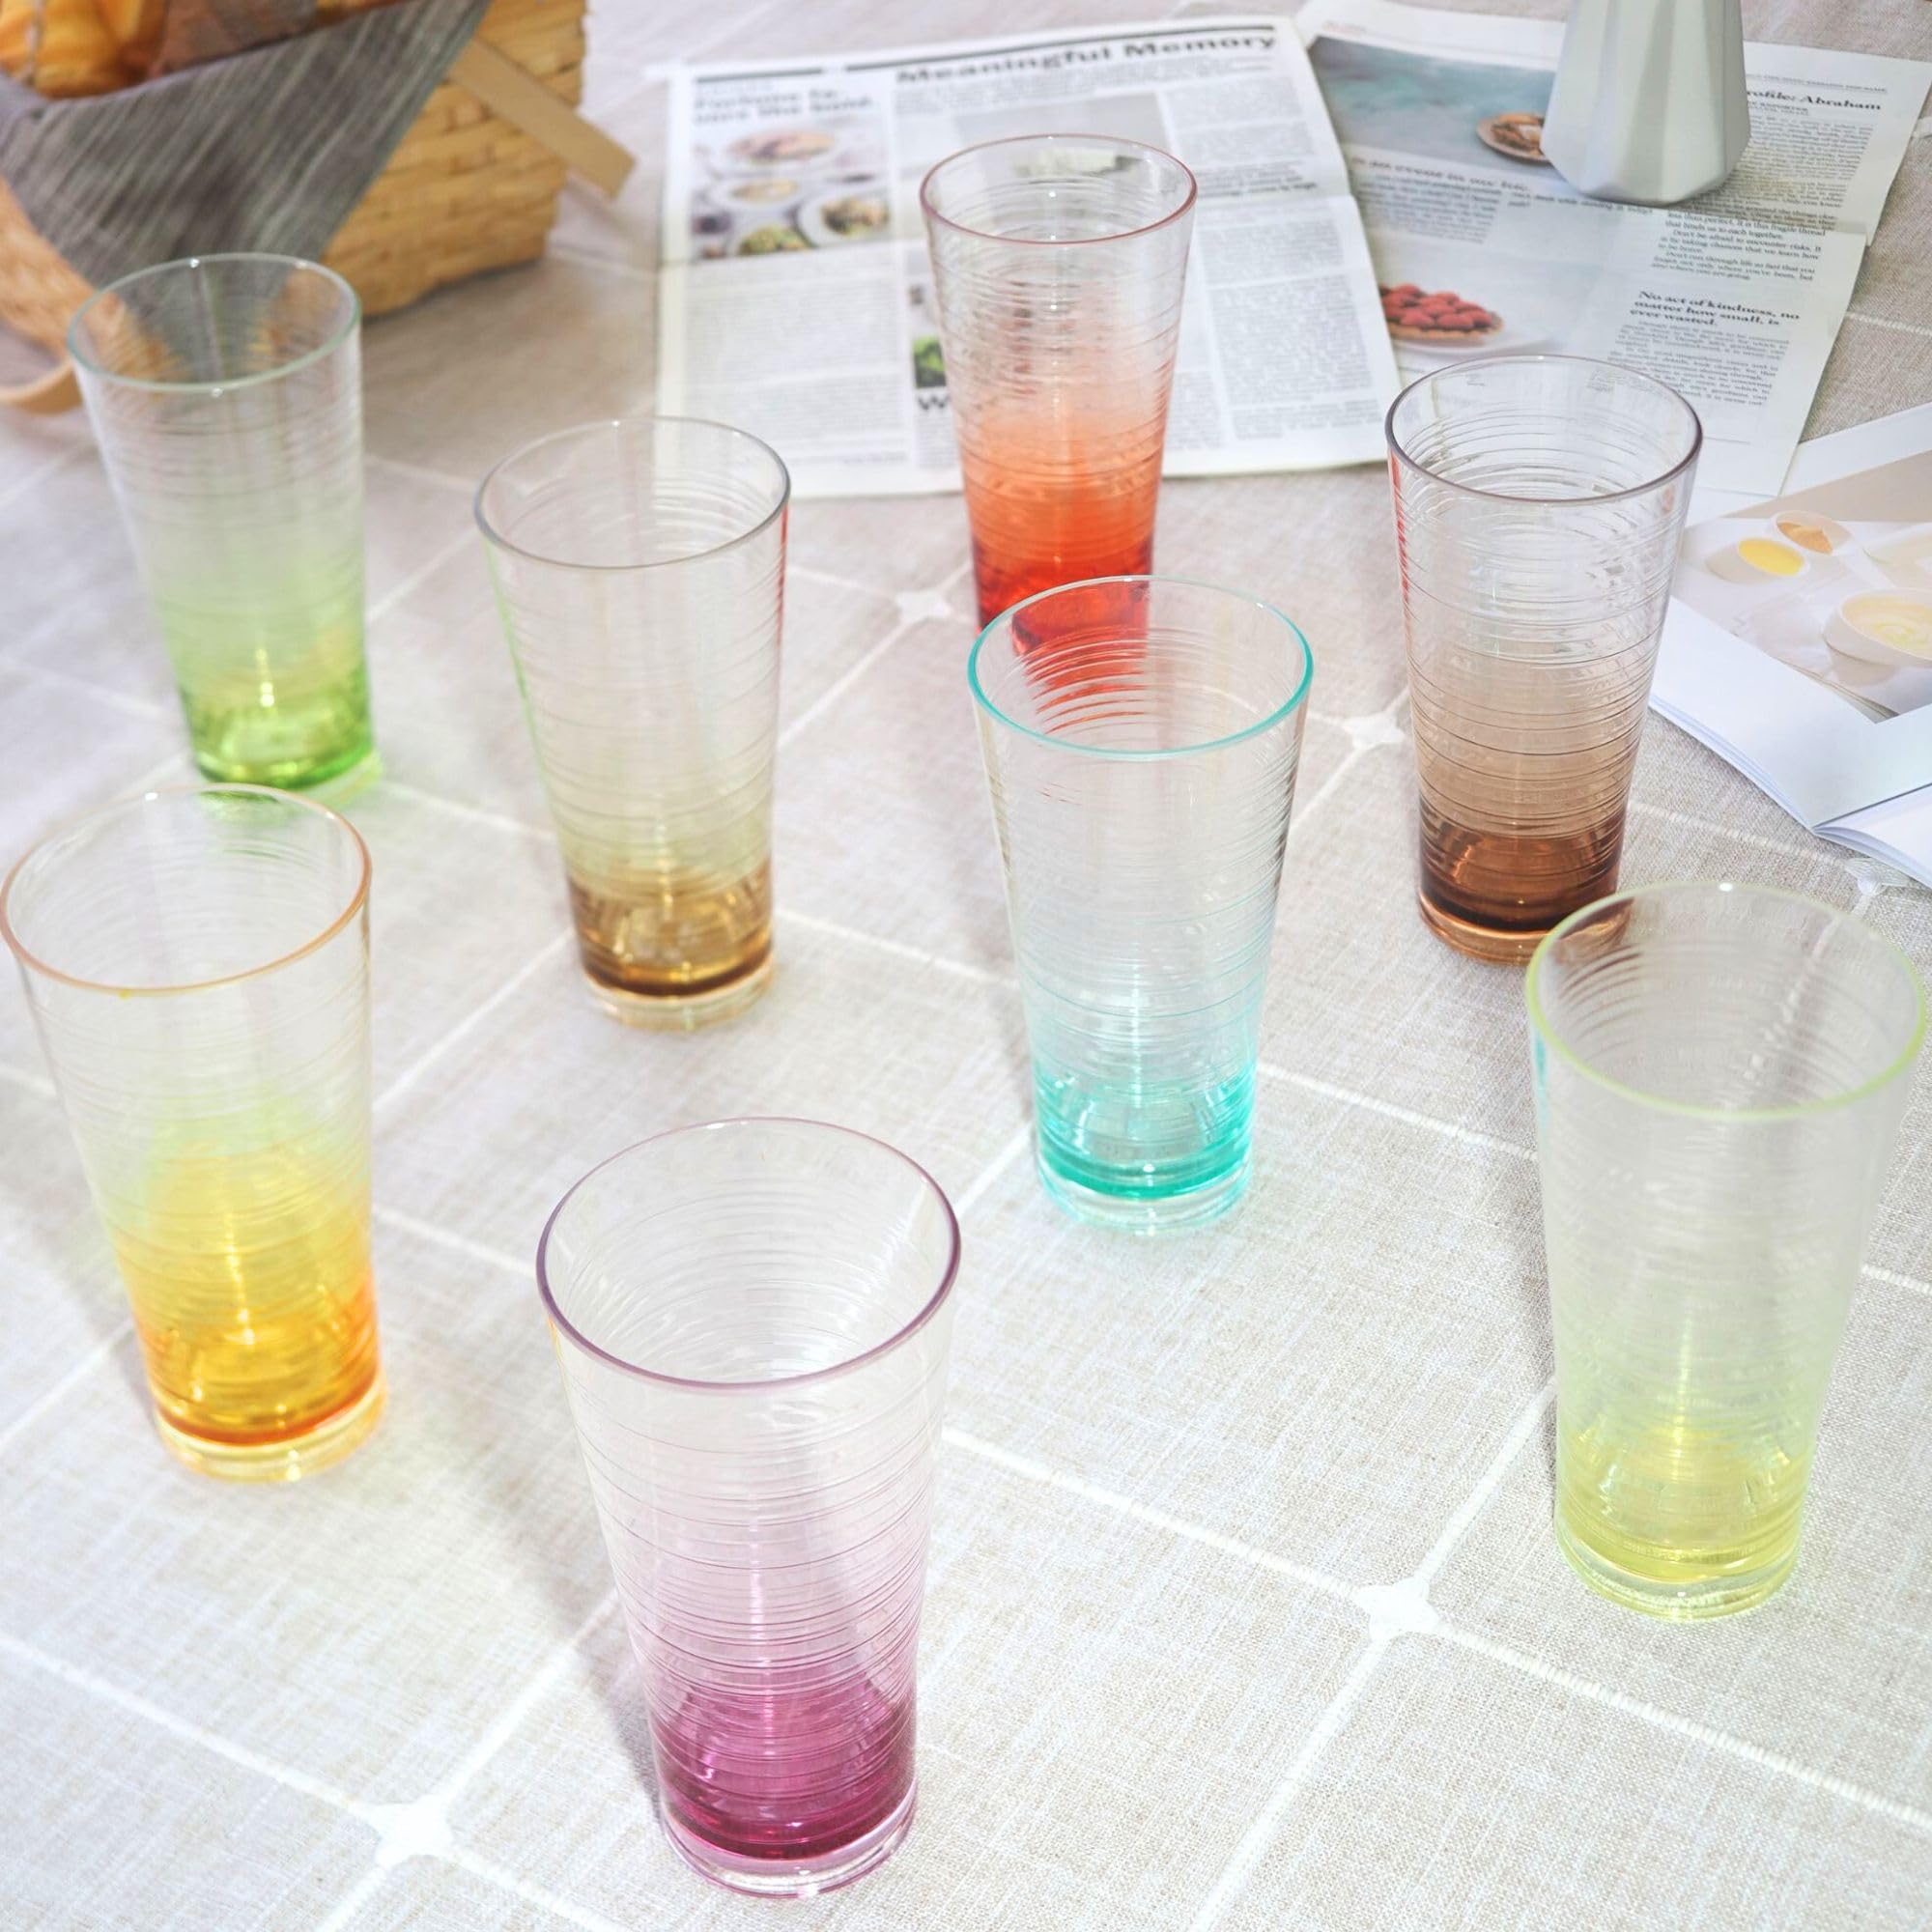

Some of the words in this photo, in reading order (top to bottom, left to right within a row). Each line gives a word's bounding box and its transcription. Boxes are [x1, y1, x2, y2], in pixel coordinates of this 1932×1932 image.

[896, 47, 1112, 83] Meaningful
[1124, 34, 1276, 59] Memory
[1747, 90, 1795, 101] rofile:
[1801, 95, 1881, 110] Abraham
[1630, 309, 1662, 318] ever
[1664, 314, 1718, 327] wasted.
[1634, 300, 1683, 312] matter
[1686, 307, 1717, 317] how
[1719, 313, 1764, 325] small,
[1639, 291, 1662, 300] No
[1664, 296, 1687, 304] act
[1689, 298, 1706, 307] of
[1707, 299, 1776, 318] kindness,
[1781, 311, 1801, 320] no
